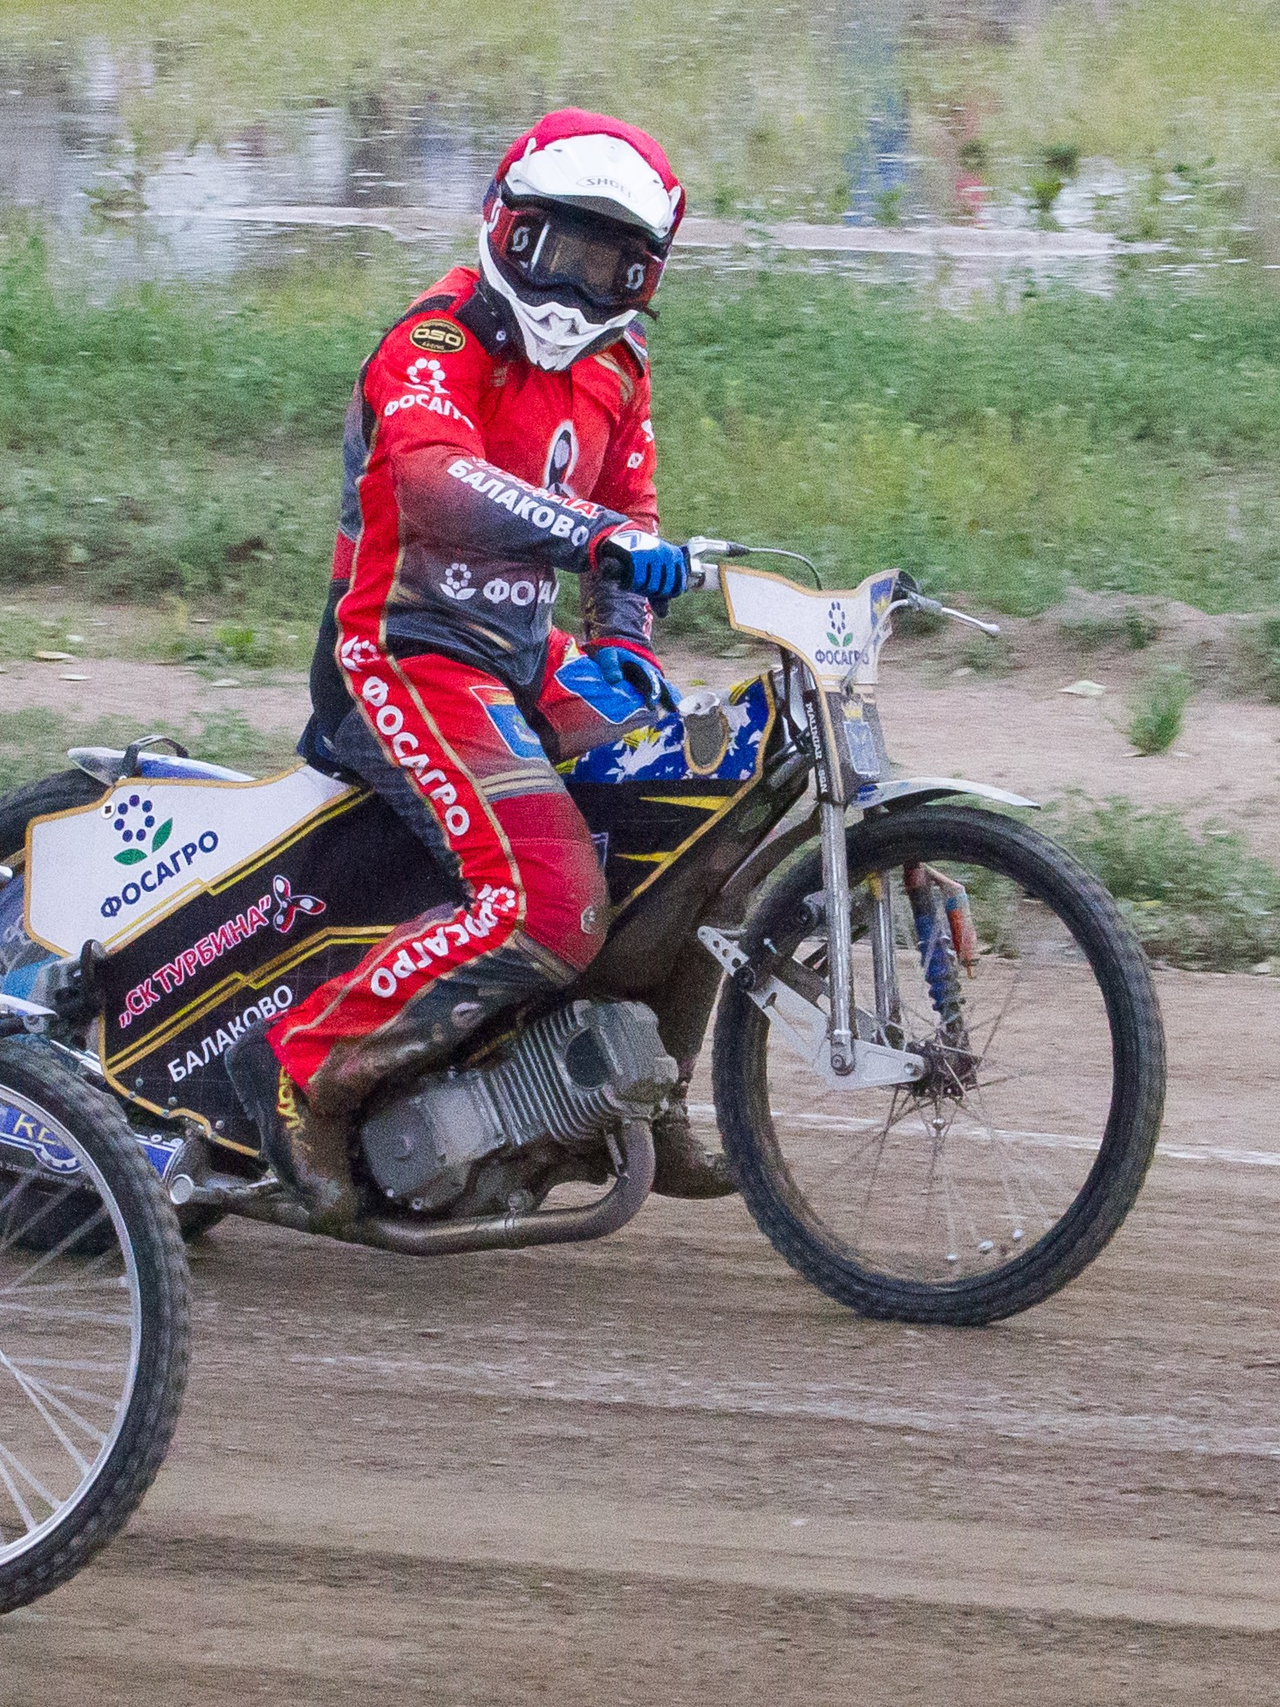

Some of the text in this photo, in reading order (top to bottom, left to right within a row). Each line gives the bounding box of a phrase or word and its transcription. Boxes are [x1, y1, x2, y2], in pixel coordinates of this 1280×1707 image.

[447, 459, 590, 547] БАЛАКОВО
[362, 676, 470, 836] ФОСАГРО
[100, 830, 219, 918] ФОСАГРО
[370, 902, 498, 998] ФОСАГРО
[168, 984, 294, 1083] БАЛАКОВО
